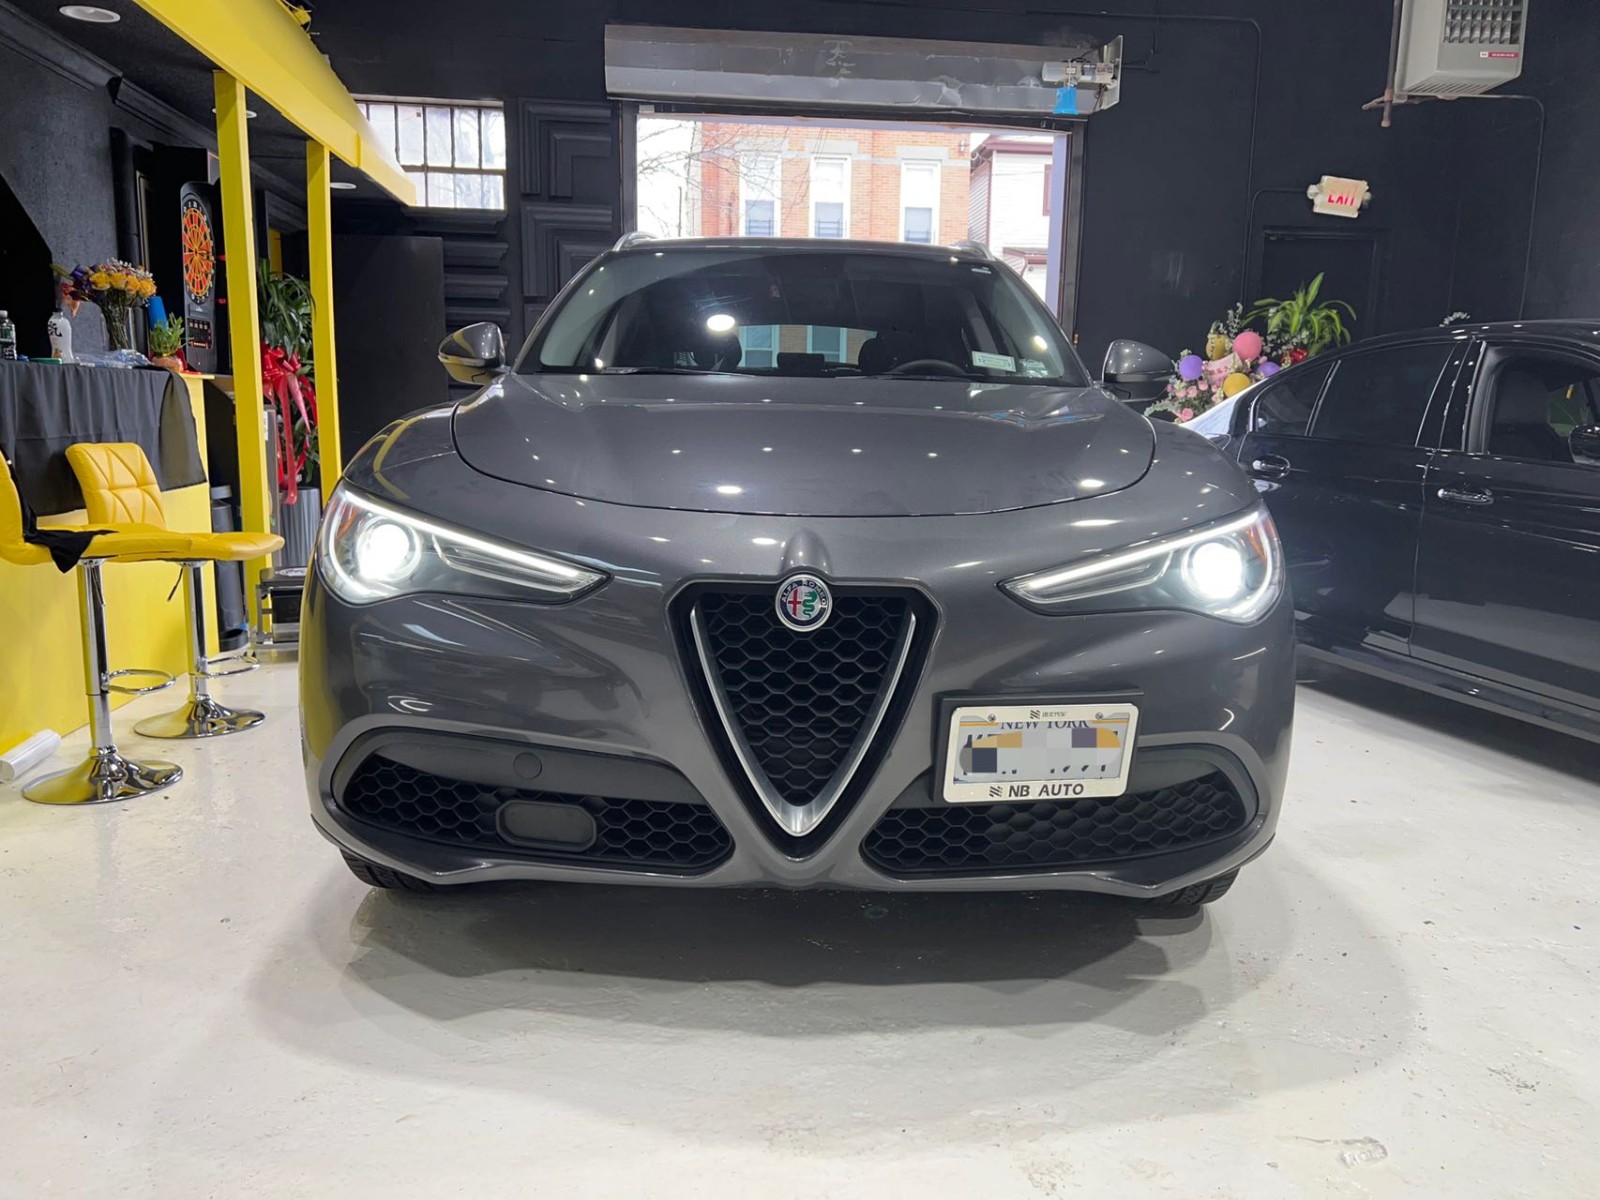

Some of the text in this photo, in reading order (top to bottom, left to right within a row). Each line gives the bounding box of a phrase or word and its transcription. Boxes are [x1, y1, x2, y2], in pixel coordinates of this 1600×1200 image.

[781, 580, 828, 606] ALFA ROMEO
[1008, 783, 1084, 798] NB AUTO
